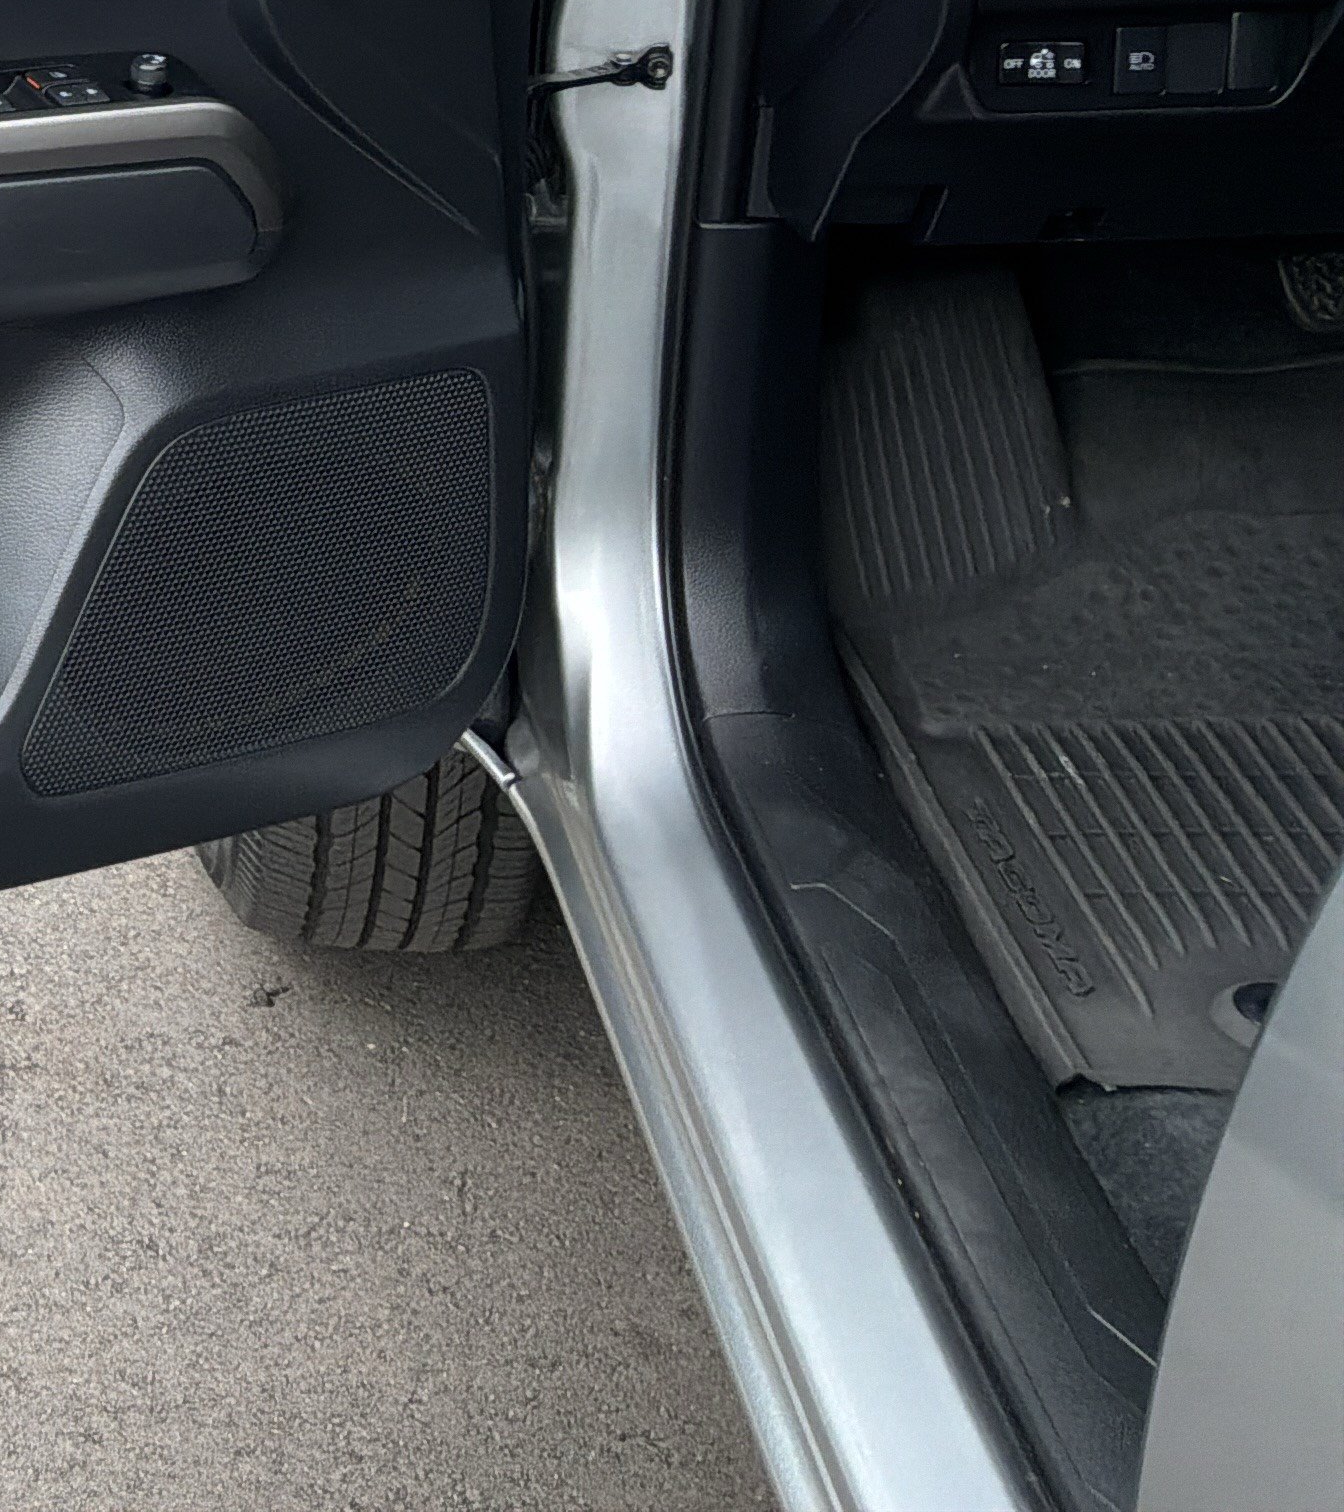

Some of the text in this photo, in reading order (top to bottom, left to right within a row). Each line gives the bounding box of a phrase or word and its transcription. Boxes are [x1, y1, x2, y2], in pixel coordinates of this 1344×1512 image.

[1003, 58, 1082, 69] OFF ON
[1128, 62, 1155, 71] AUTO
[1027, 68, 1057, 79] DOOR
[961, 797, 1097, 998] TACOMA
